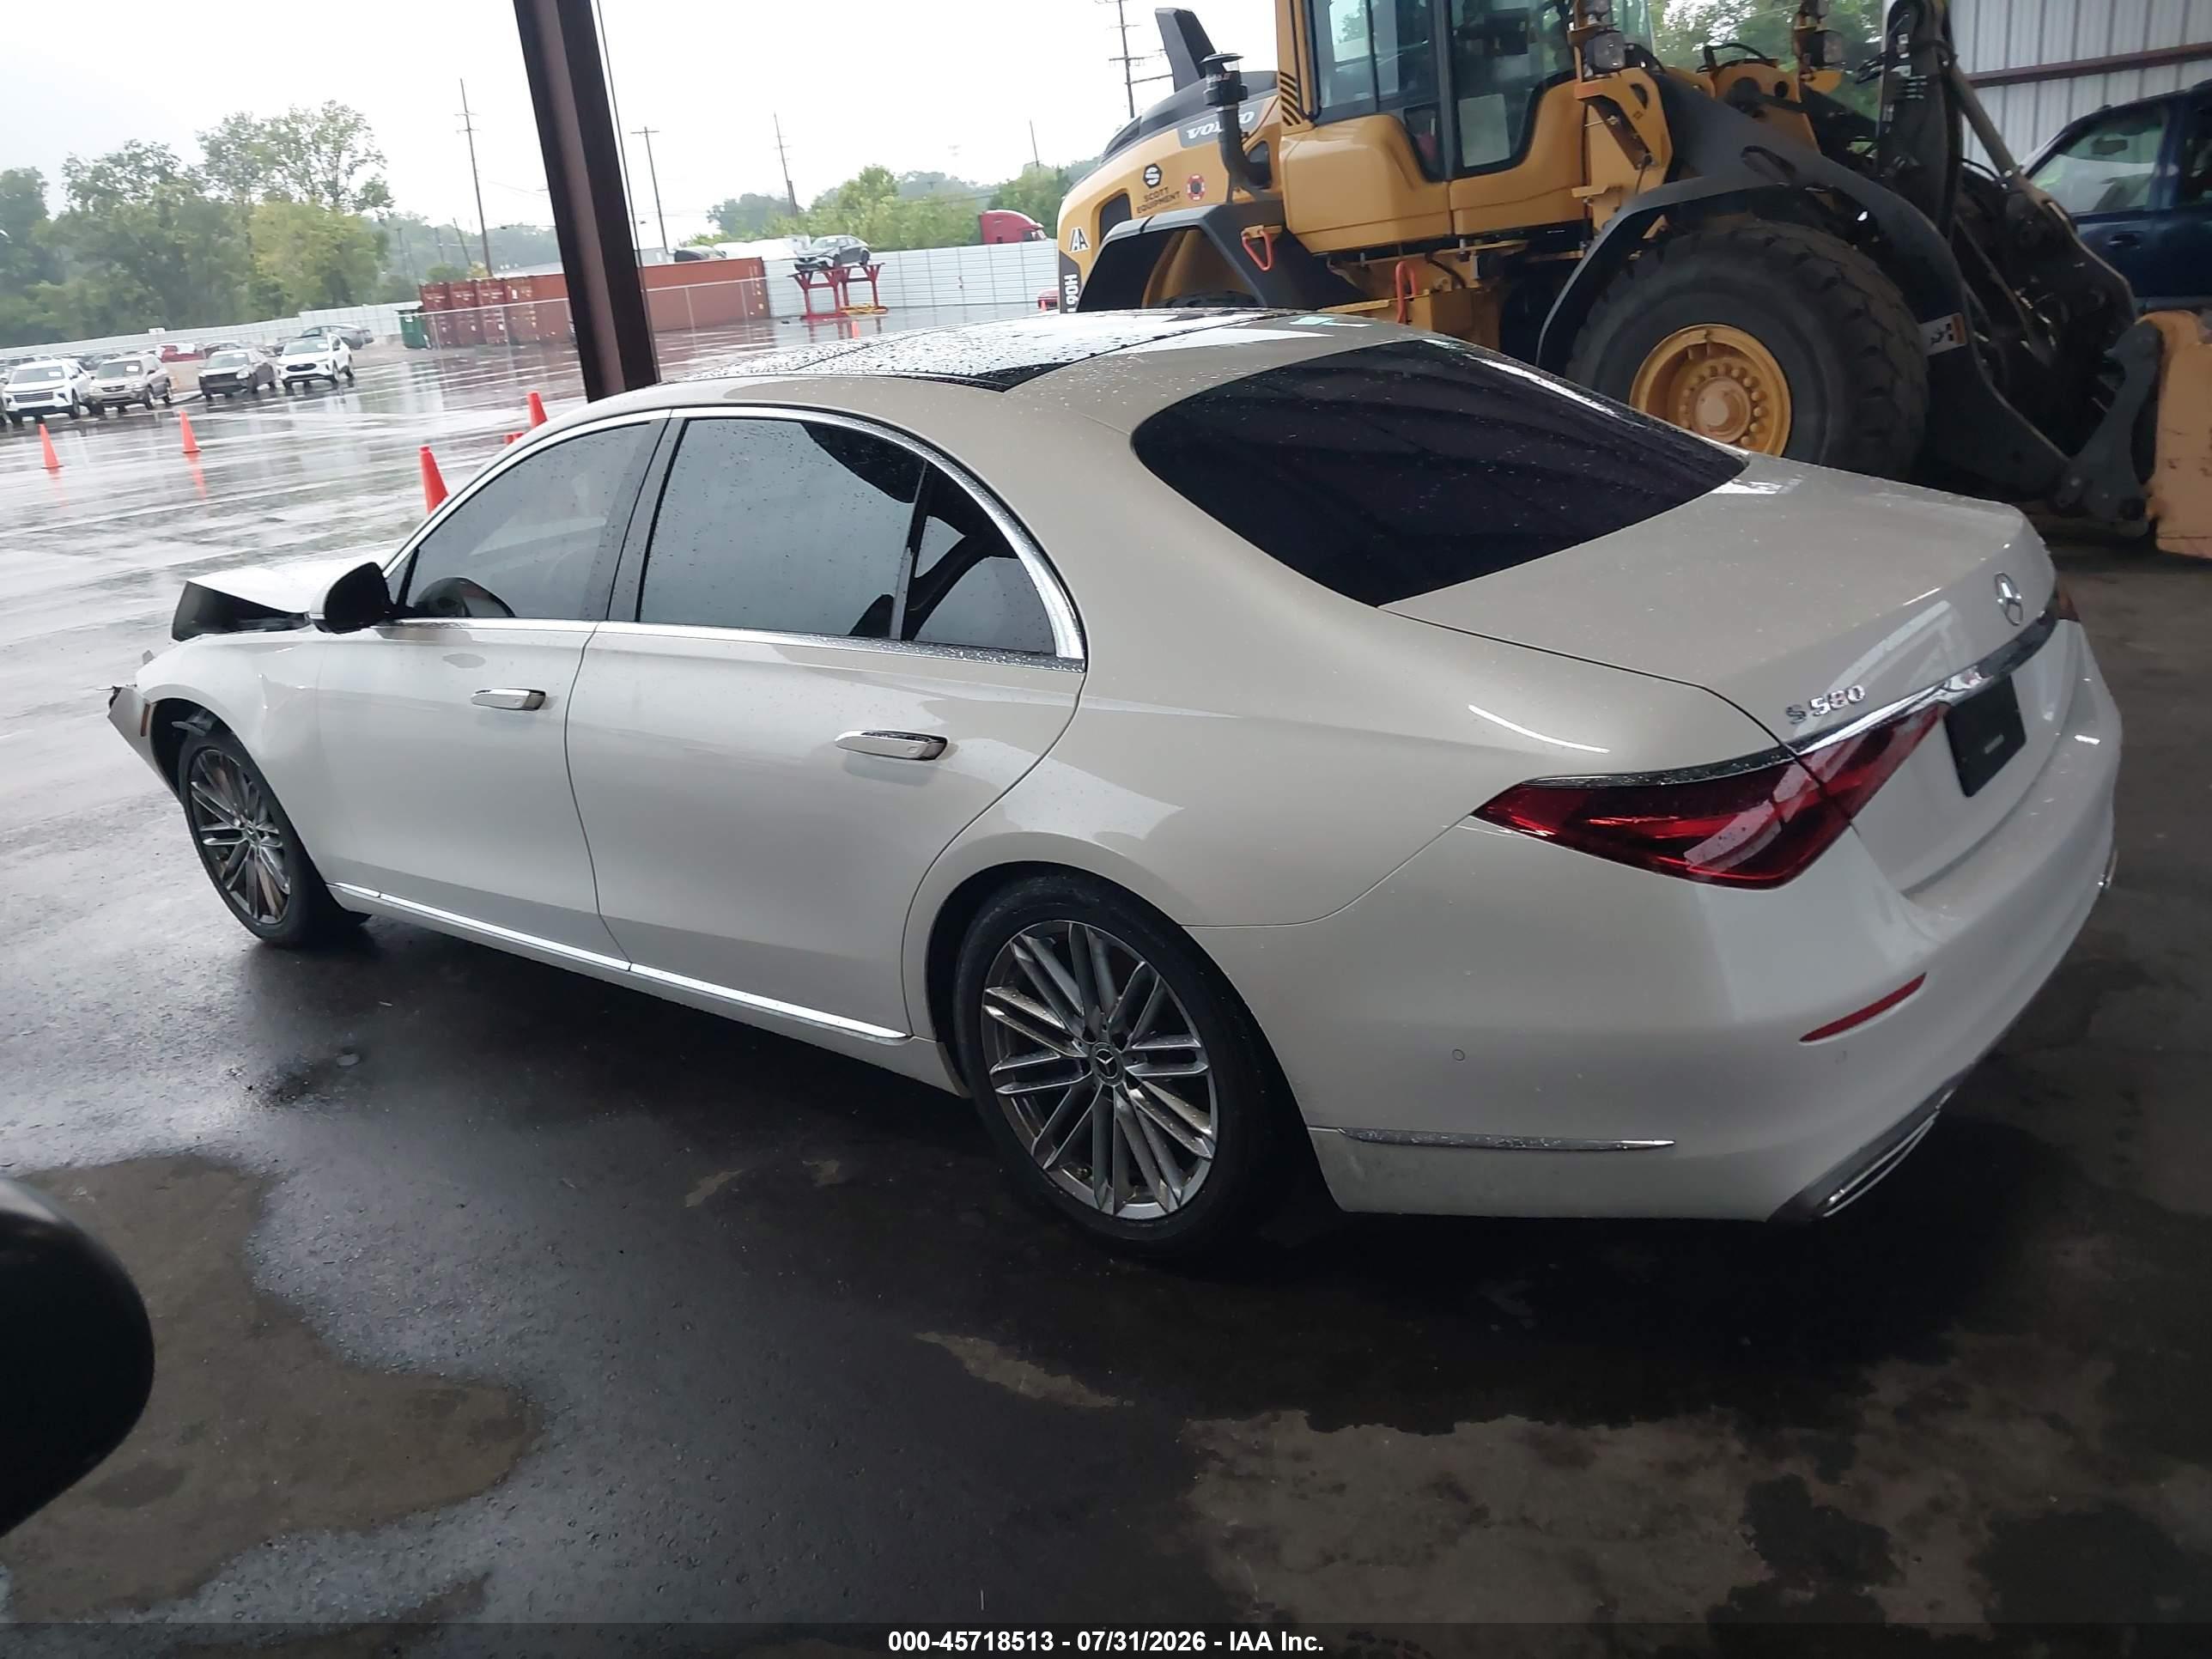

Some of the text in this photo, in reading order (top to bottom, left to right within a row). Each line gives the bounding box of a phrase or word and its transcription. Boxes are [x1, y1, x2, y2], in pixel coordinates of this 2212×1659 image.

[1187, 112, 1255, 139] VOLO
[1136, 191, 1181, 213] EQUIPMENT
[1144, 186, 1169, 202] SCOTT
[1786, 684, 1865, 725] S 580
